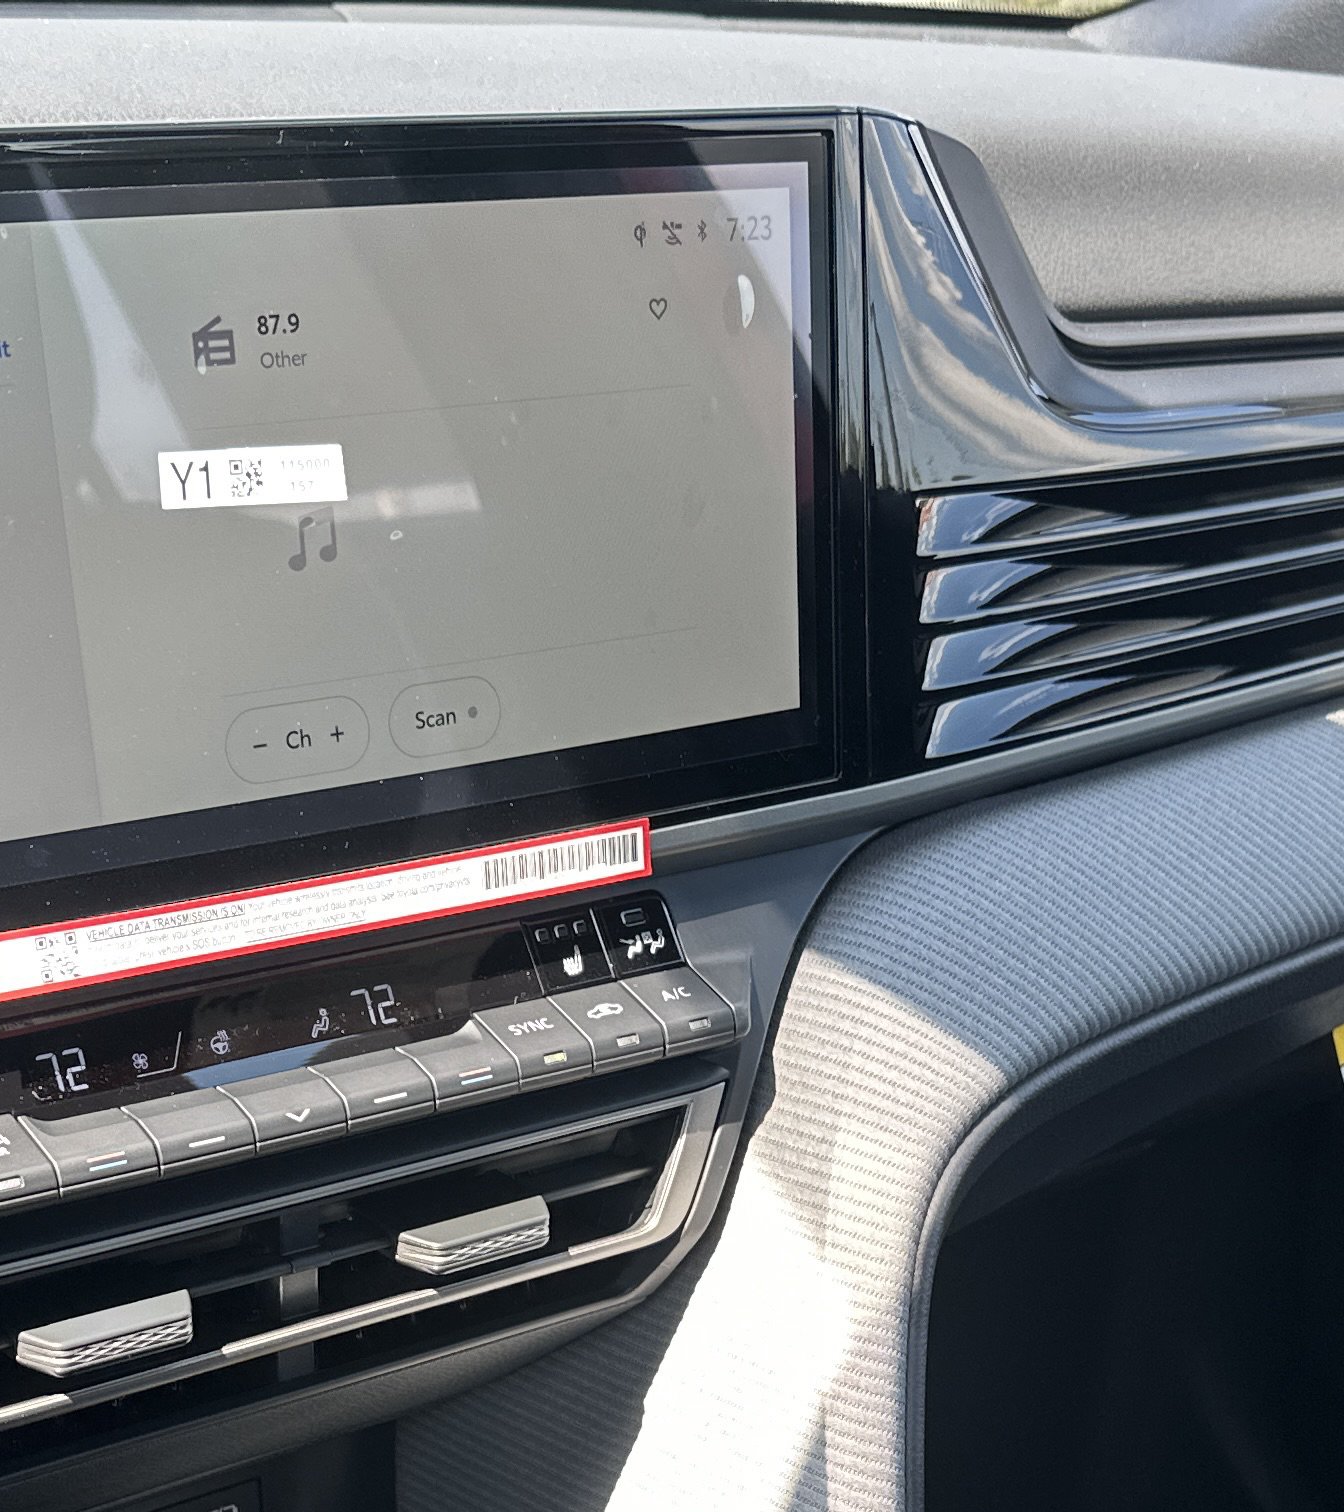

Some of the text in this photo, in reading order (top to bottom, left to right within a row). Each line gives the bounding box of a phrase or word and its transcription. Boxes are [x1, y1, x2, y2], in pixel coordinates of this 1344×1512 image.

[727, 216, 772, 242] 7:23
[257, 313, 300, 335] 87.9
[260, 352, 307, 369] Other
[170, 460, 211, 500] Y1
[415, 711, 457, 730] Scan
[286, 729, 312, 750] Ch
[662, 985, 691, 1002] A/C
[350, 984, 397, 1027] 72
[507, 1015, 555, 1038] SYNC
[35, 1048, 89, 1093] 72
